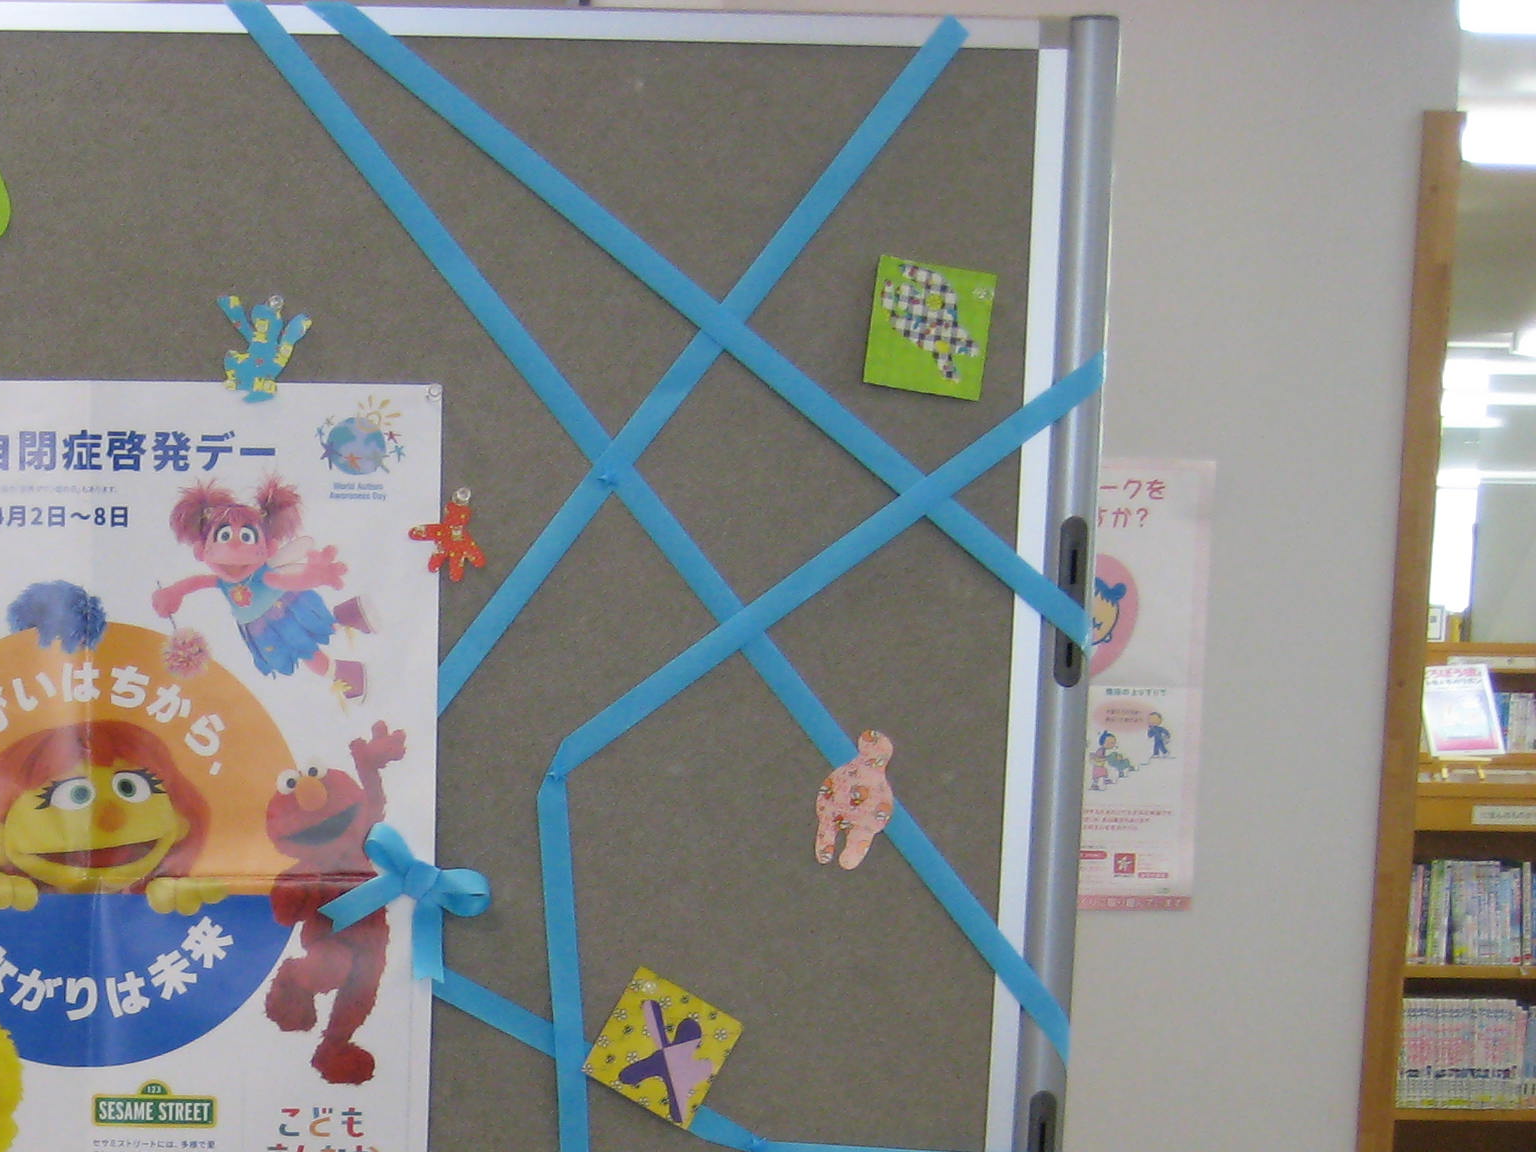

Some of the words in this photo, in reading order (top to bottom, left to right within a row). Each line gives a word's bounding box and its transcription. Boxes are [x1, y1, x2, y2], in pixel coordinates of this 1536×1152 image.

[99, 1101, 154, 1121] SESAME
[158, 1102, 212, 1121] STREET
[279, 1107, 365, 1139] こども
